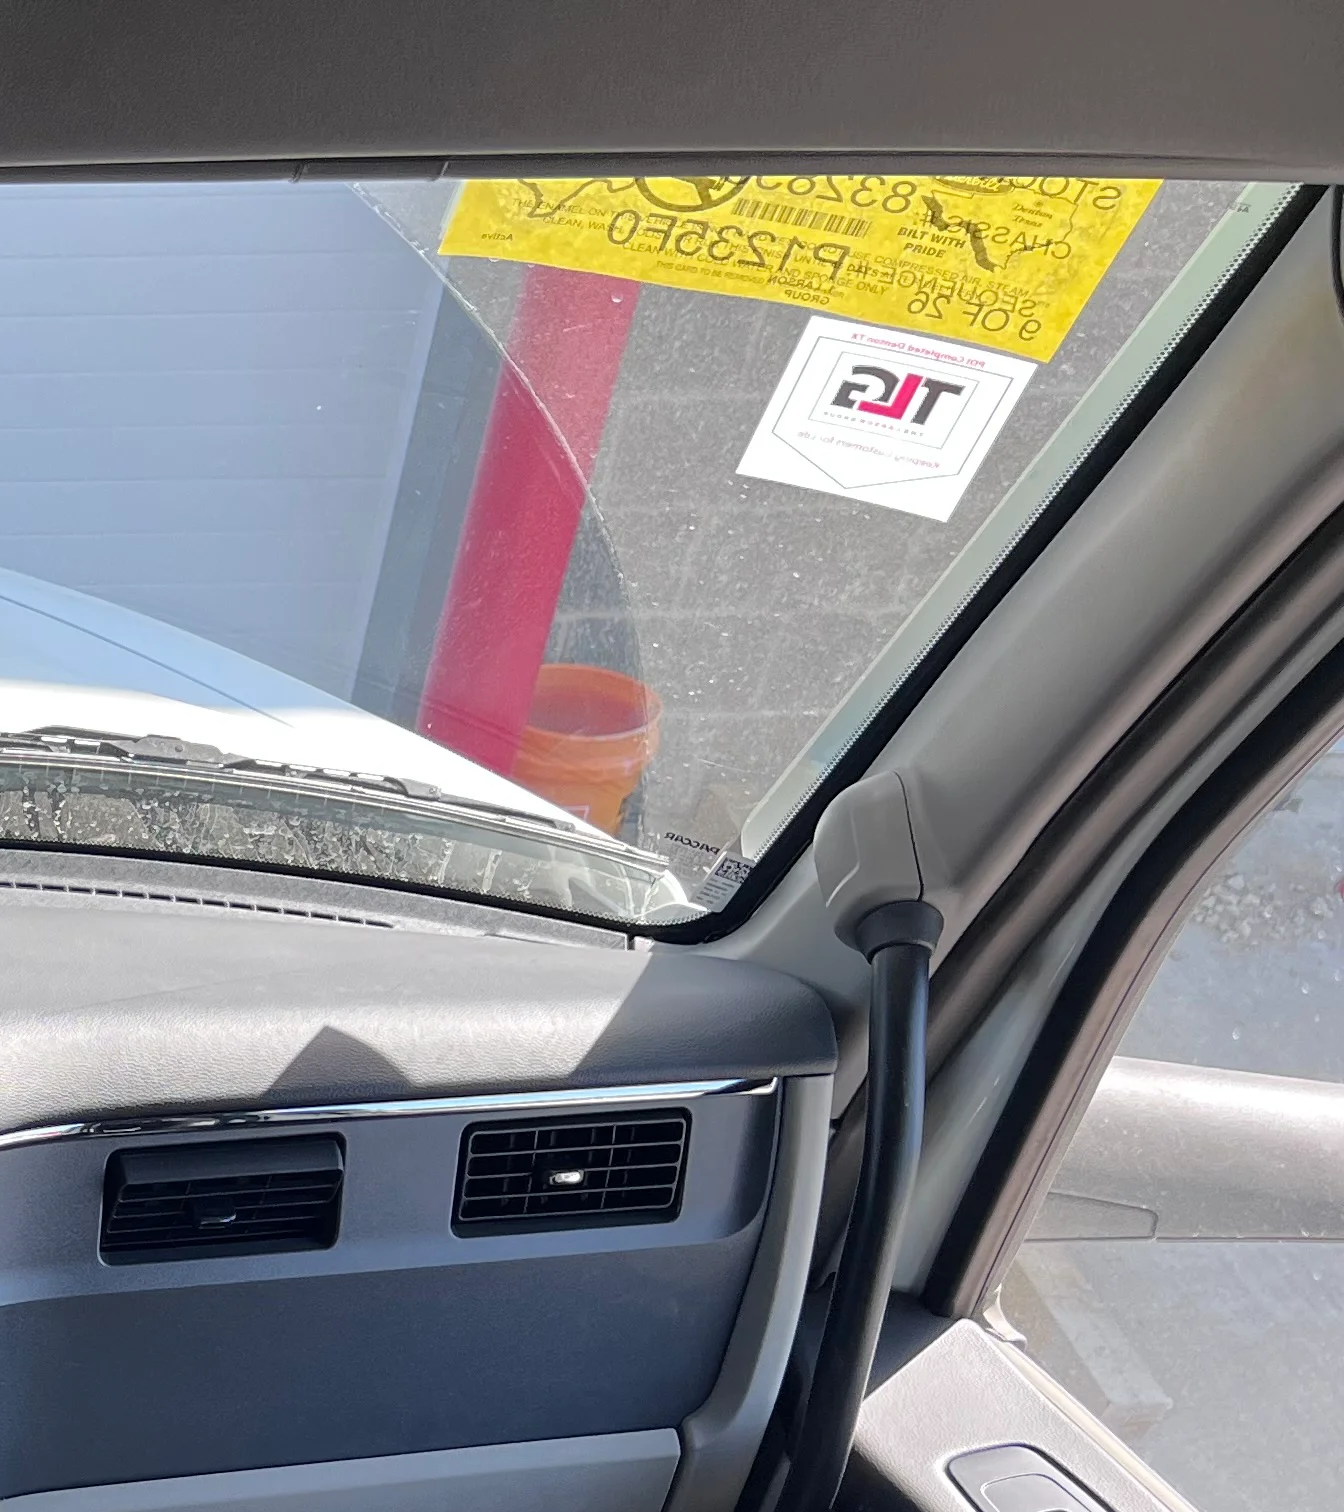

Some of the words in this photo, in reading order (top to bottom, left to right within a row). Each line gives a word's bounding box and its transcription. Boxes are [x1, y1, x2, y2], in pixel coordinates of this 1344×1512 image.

[930, 231, 967, 250] WITH
[903, 242, 947, 259] PRIDE
[855, 279, 889, 296] ONLY
[987, 280, 1030, 298] STEAM
